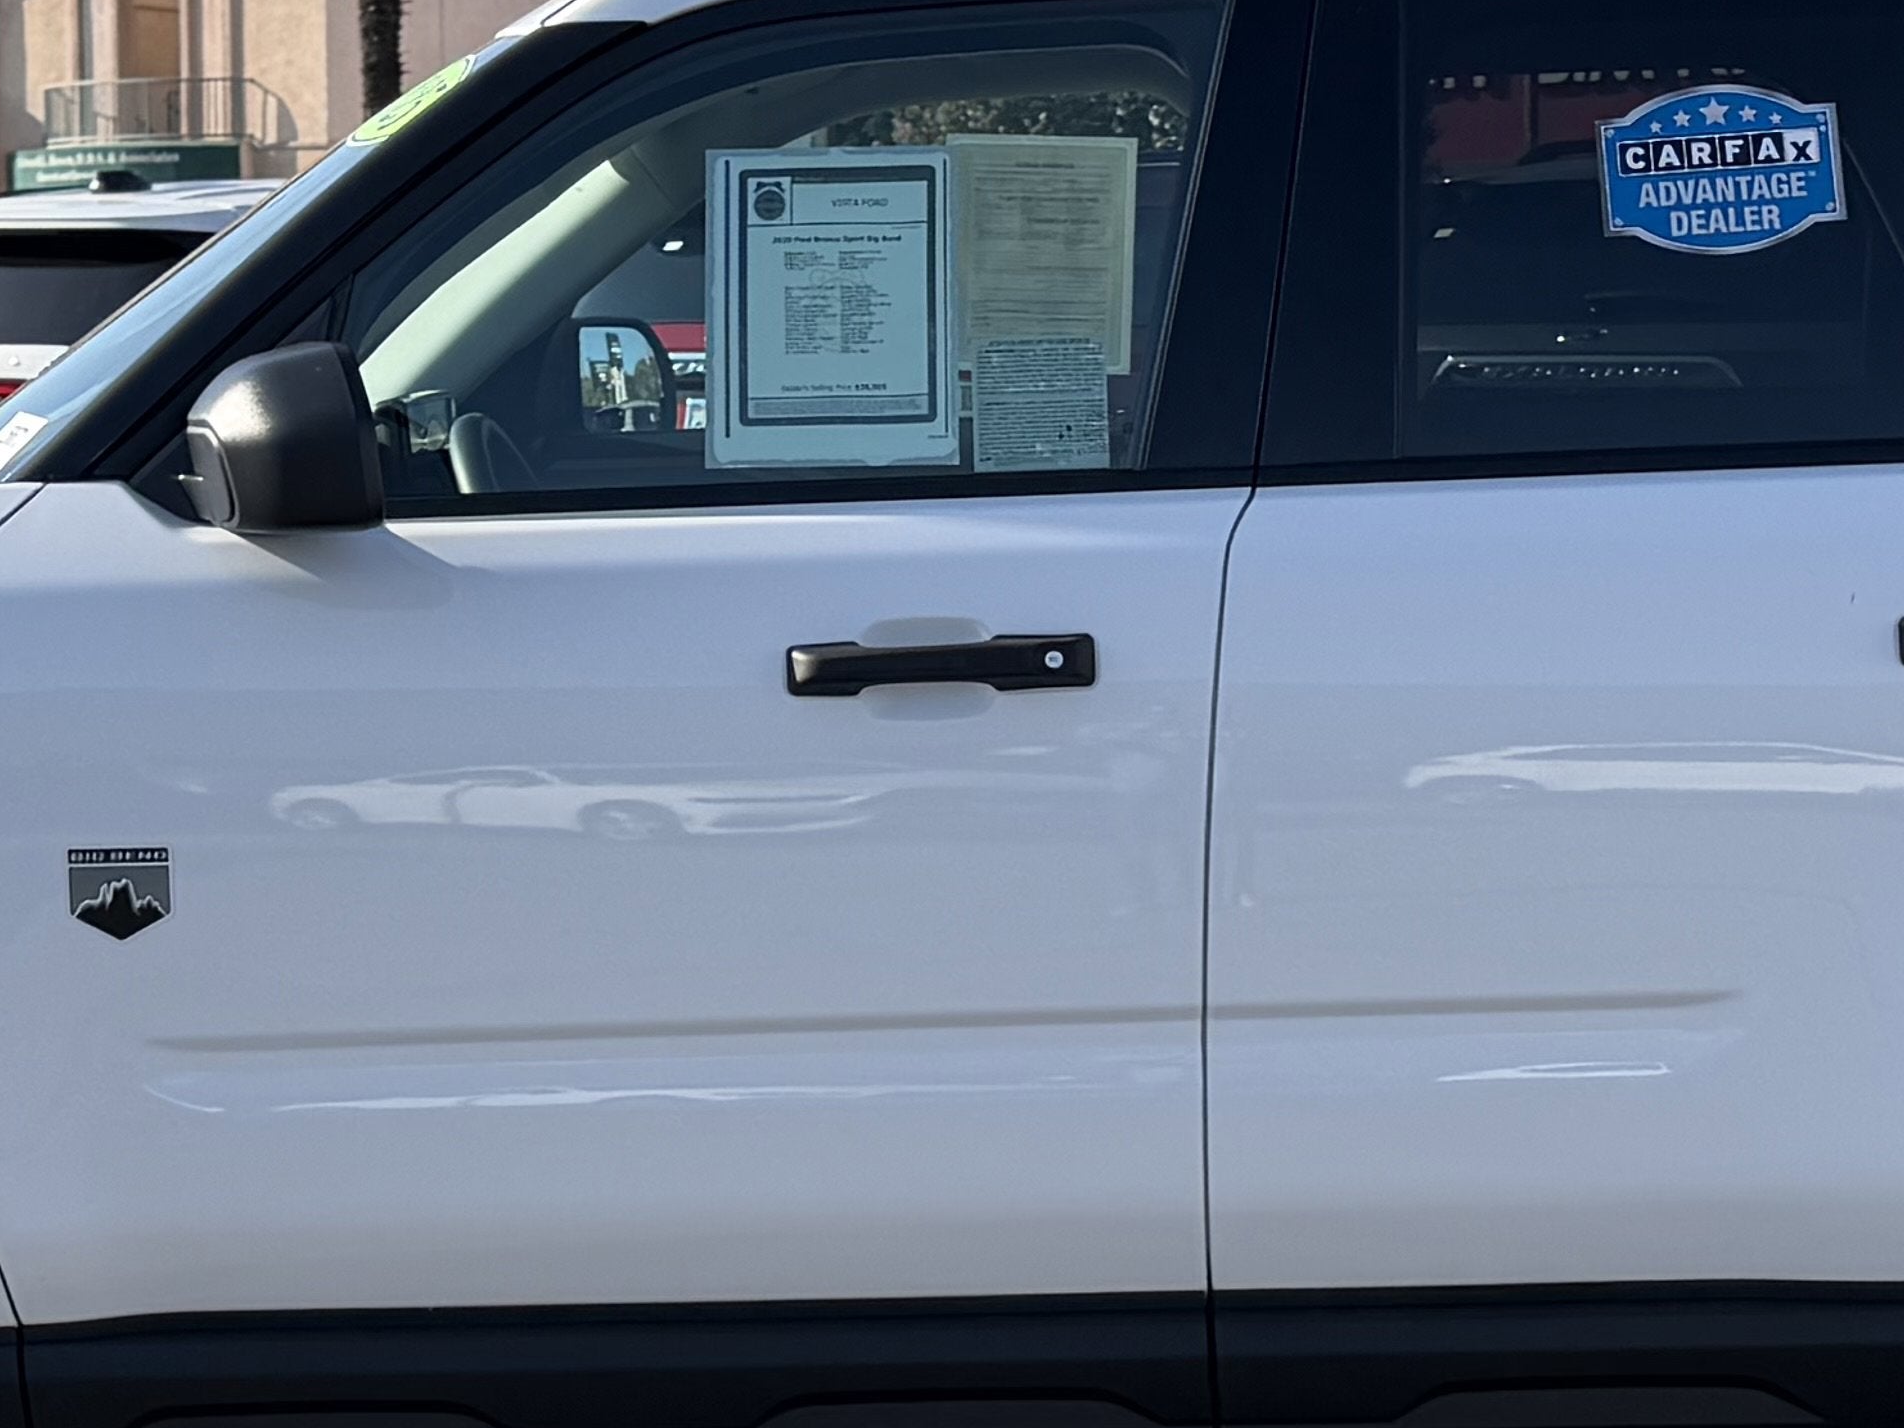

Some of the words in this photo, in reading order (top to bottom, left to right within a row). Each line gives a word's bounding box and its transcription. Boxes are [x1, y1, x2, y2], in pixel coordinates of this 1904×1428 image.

[1625, 135, 1813, 170] CARFAX
[1669, 205, 1781, 237] DEALER
[110, 850, 167, 861] BEND
